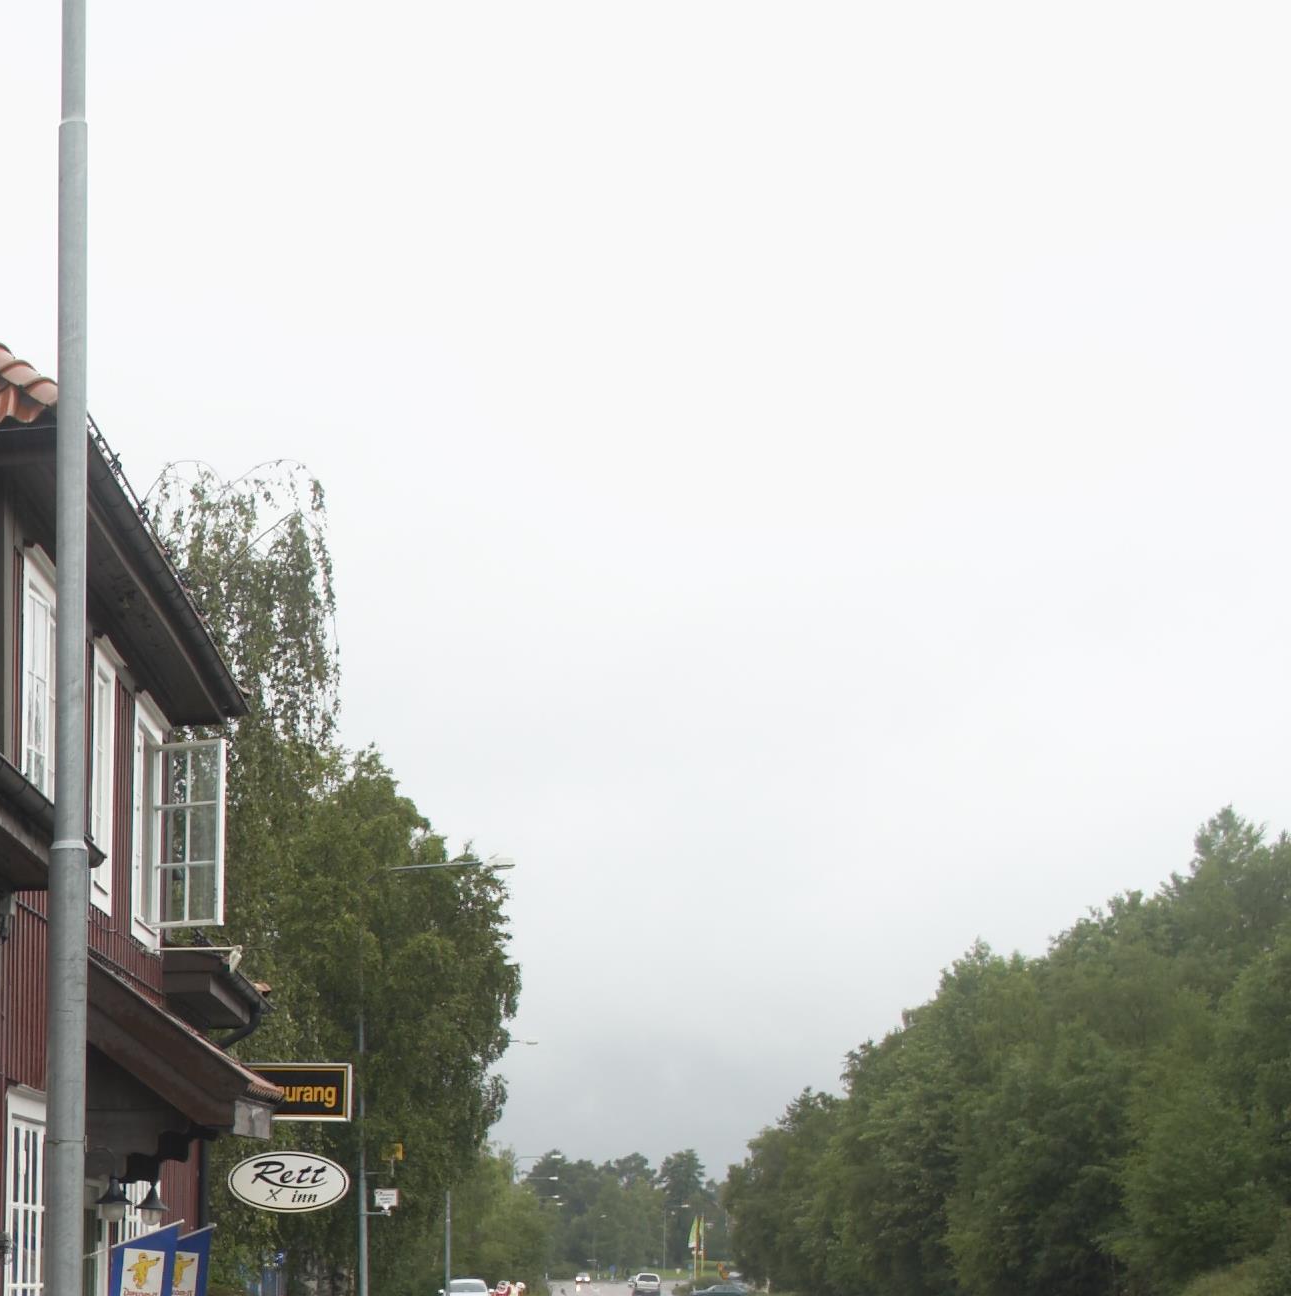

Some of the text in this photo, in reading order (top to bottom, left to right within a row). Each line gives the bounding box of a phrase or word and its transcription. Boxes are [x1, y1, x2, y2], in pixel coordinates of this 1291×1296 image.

[280, 1085, 337, 1108] urang
[251, 1160, 328, 1189] Rett
[291, 1189, 318, 1203] inn
